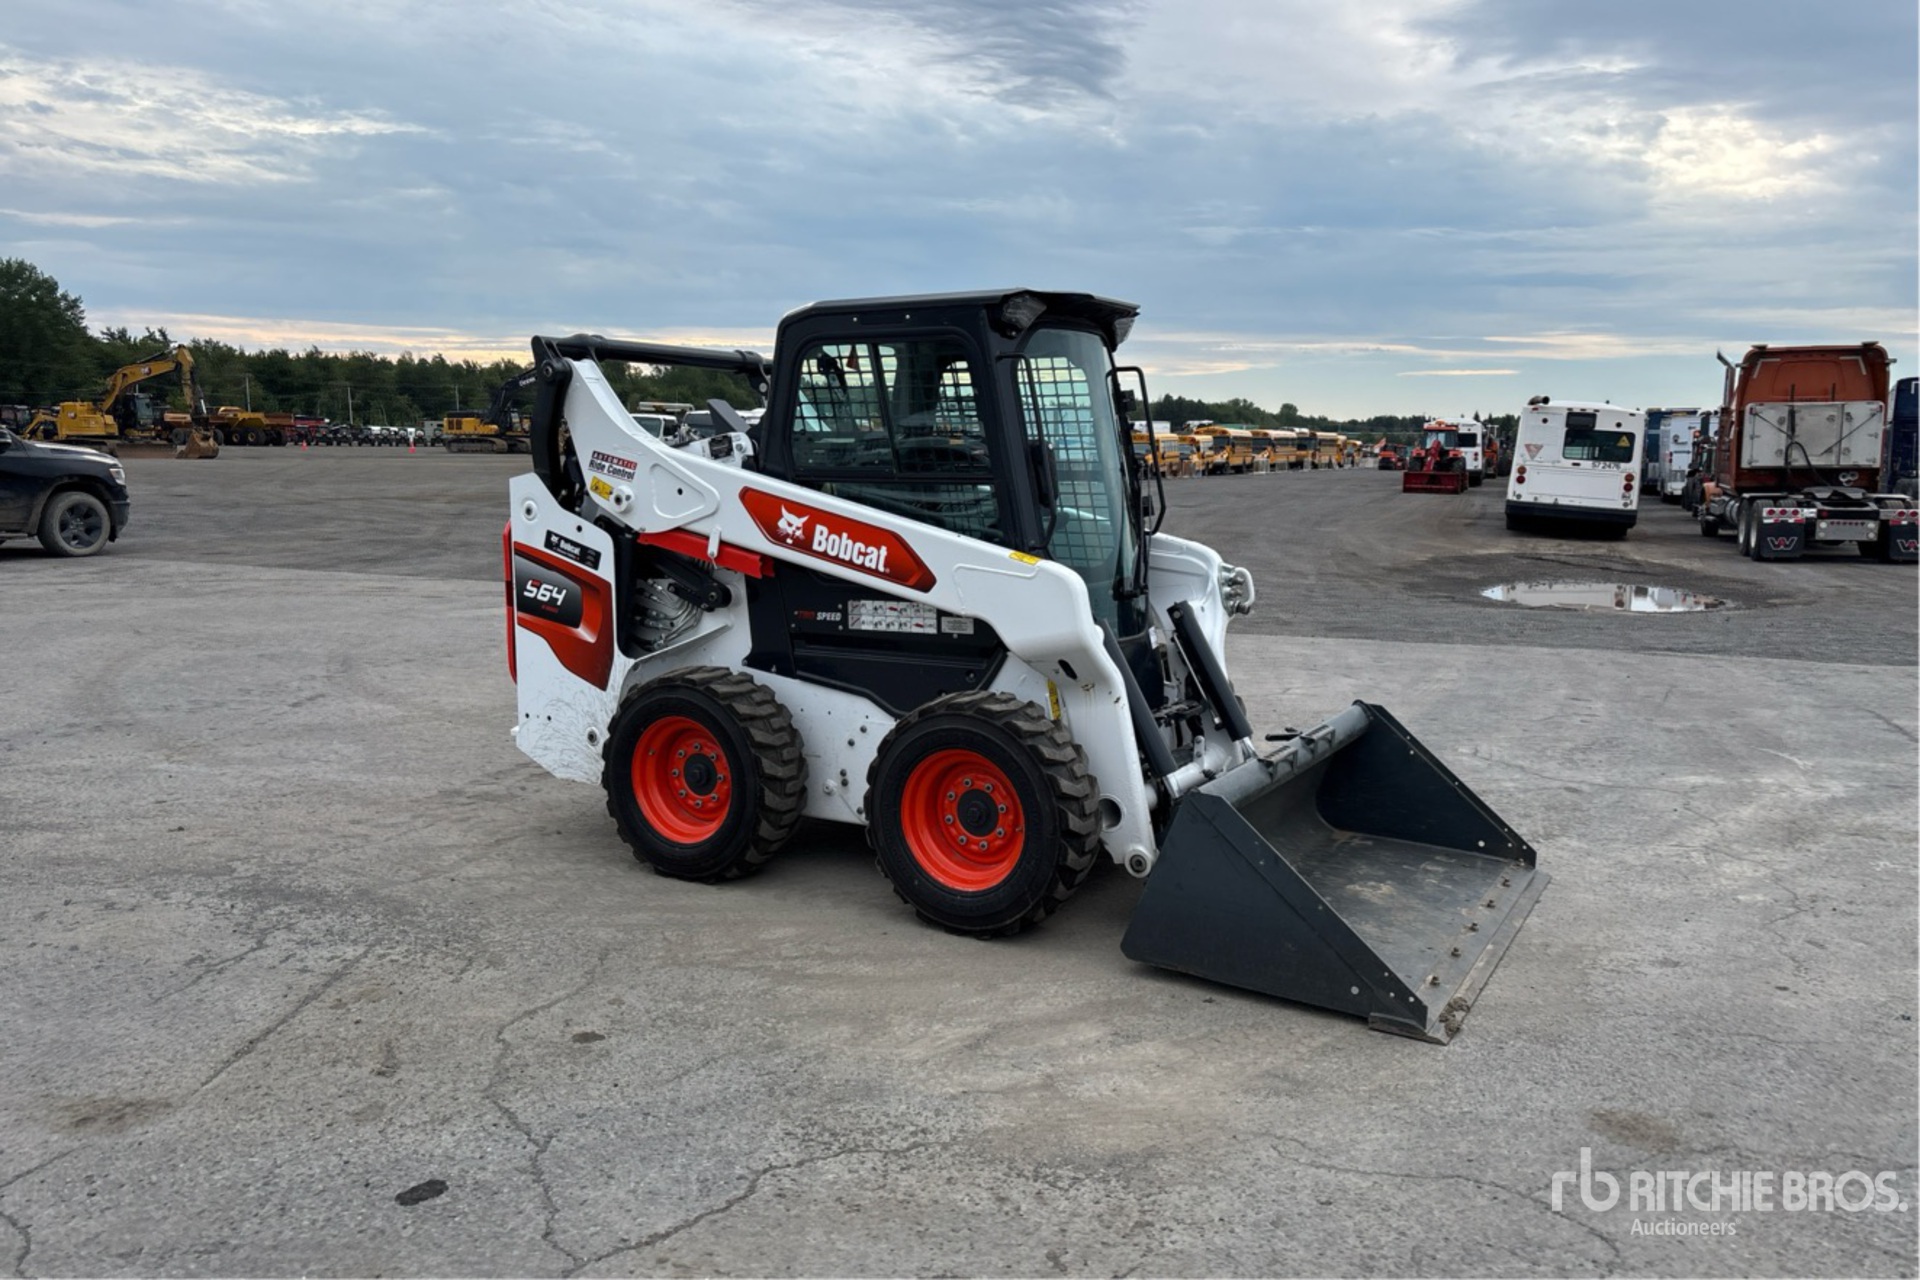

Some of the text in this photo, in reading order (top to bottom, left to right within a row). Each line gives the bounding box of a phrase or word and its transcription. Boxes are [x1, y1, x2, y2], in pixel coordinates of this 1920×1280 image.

[607, 464, 636, 480] Control
[812, 524, 888, 573] Bobcat
[523, 579, 567, 606] S64
[816, 612, 842, 622] SPEED
